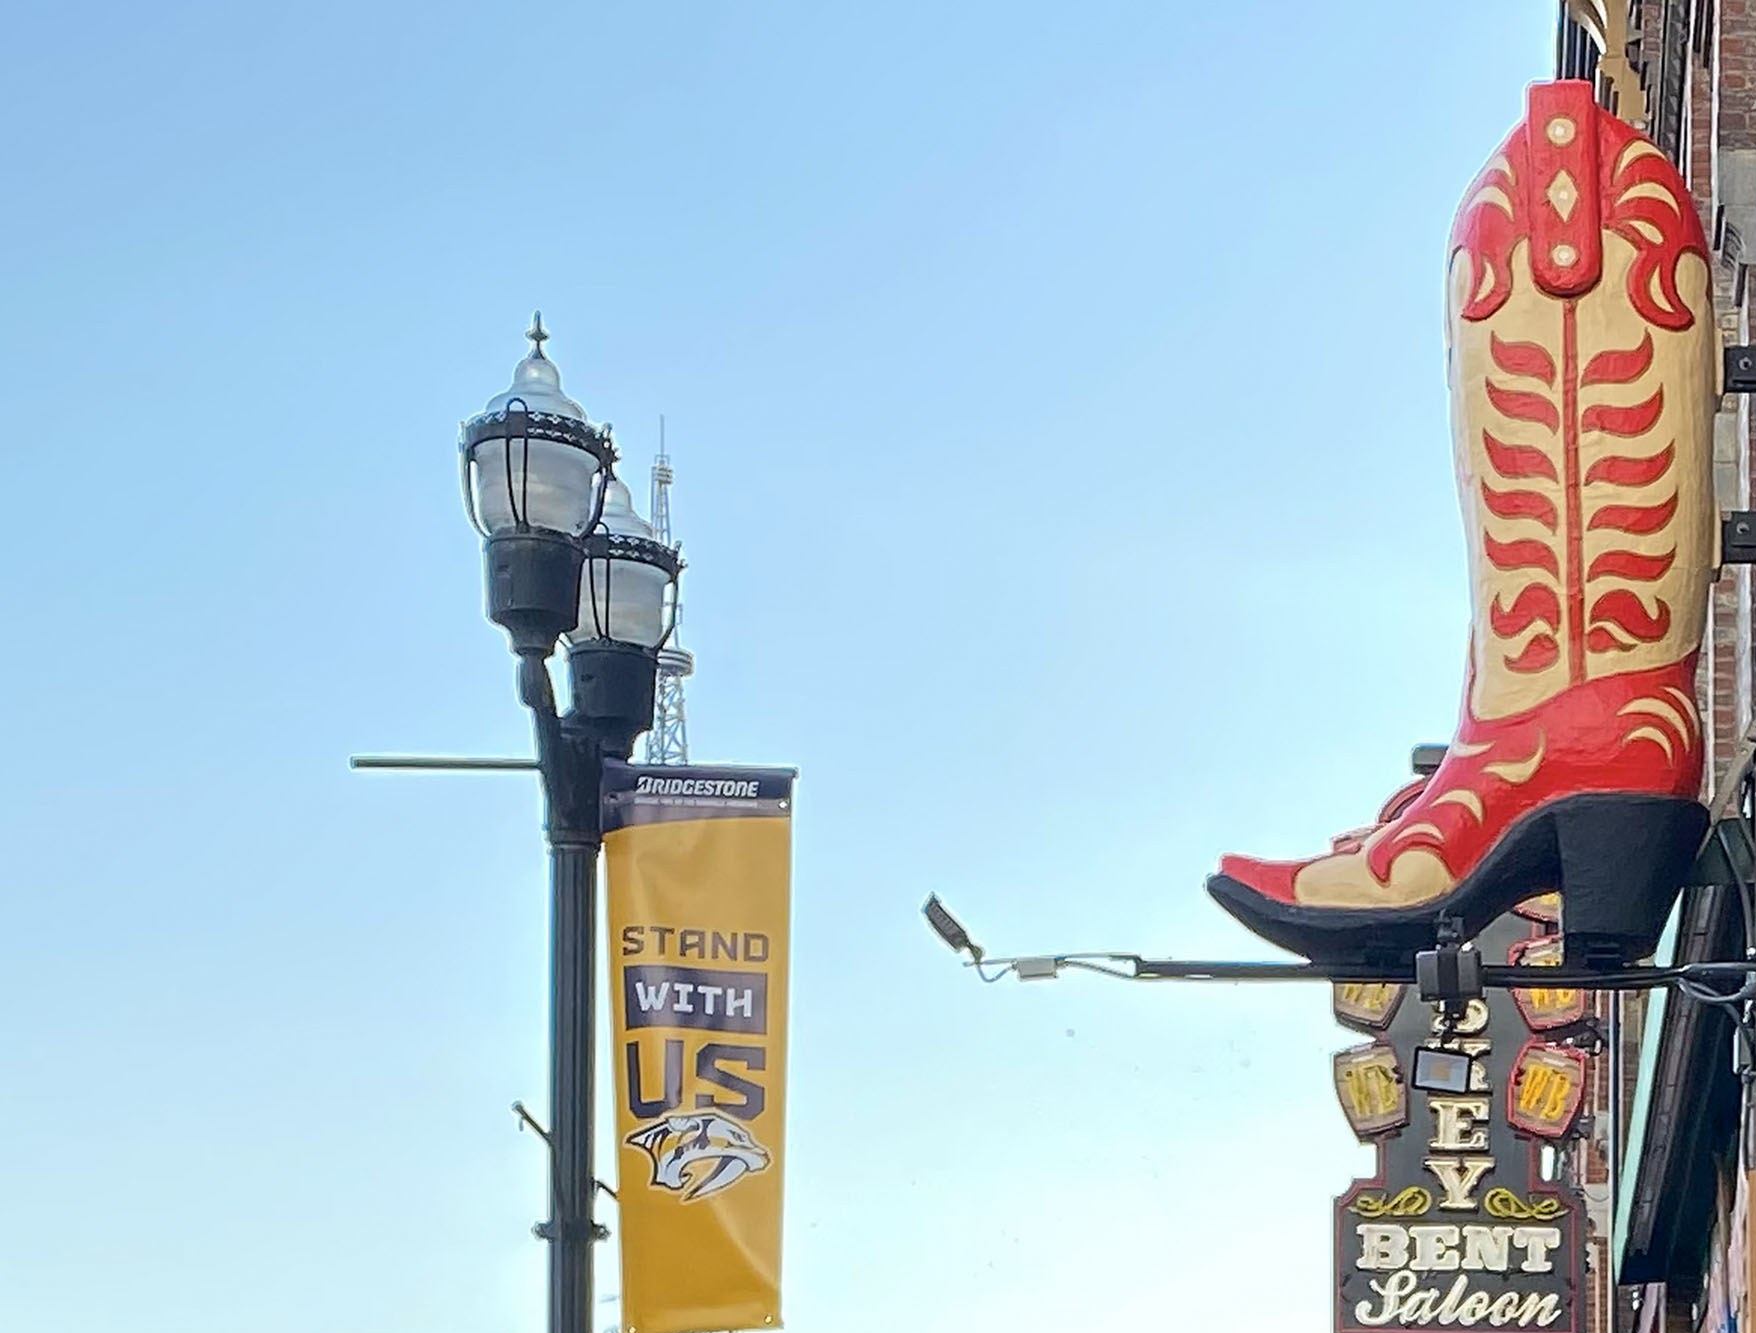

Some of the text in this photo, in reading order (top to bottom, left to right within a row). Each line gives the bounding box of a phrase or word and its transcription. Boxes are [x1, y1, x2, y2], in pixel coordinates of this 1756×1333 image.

[635, 776, 759, 797] BRIDGESTONE
[622, 926, 769, 962] STAND
[635, 981, 753, 1018] WITH
[626, 1040, 766, 1121] US
[1356, 1223, 1560, 1273] BENT
[1355, 1270, 1563, 1328] Saloon
